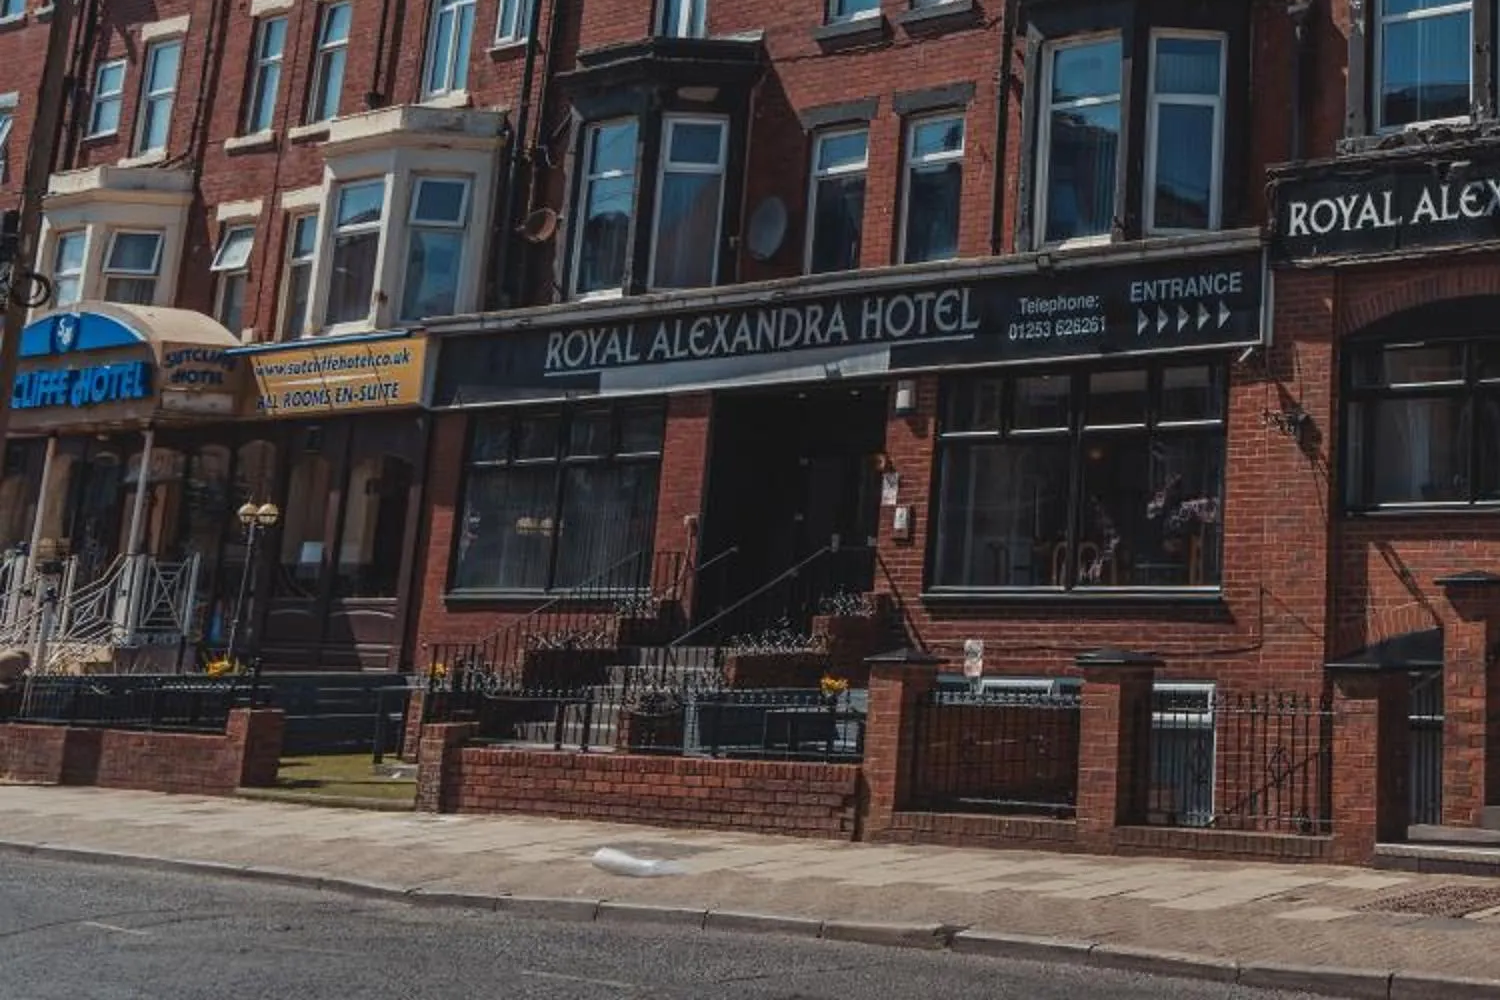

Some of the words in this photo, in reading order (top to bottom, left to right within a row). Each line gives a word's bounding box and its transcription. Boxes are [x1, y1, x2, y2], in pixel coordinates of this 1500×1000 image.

[1288, 191, 1402, 237] ROYAL
[1130, 271, 1243, 302] ENTRANCE
[1019, 295, 1100, 316] Telephone:
[545, 326, 640, 371] ROYAL
[647, 299, 848, 361] ALEXANDRA
[861, 287, 981, 340] HOTEL
[1008, 321, 1051, 341] 01253
[1055, 316, 1106, 336] 626261
[11, 369, 69, 409] CLIFFE
[70, 360, 145, 408] HOTEL
[283, 388, 332, 408] ROOMS
[336, 382, 400, 405] EN-SUITE
